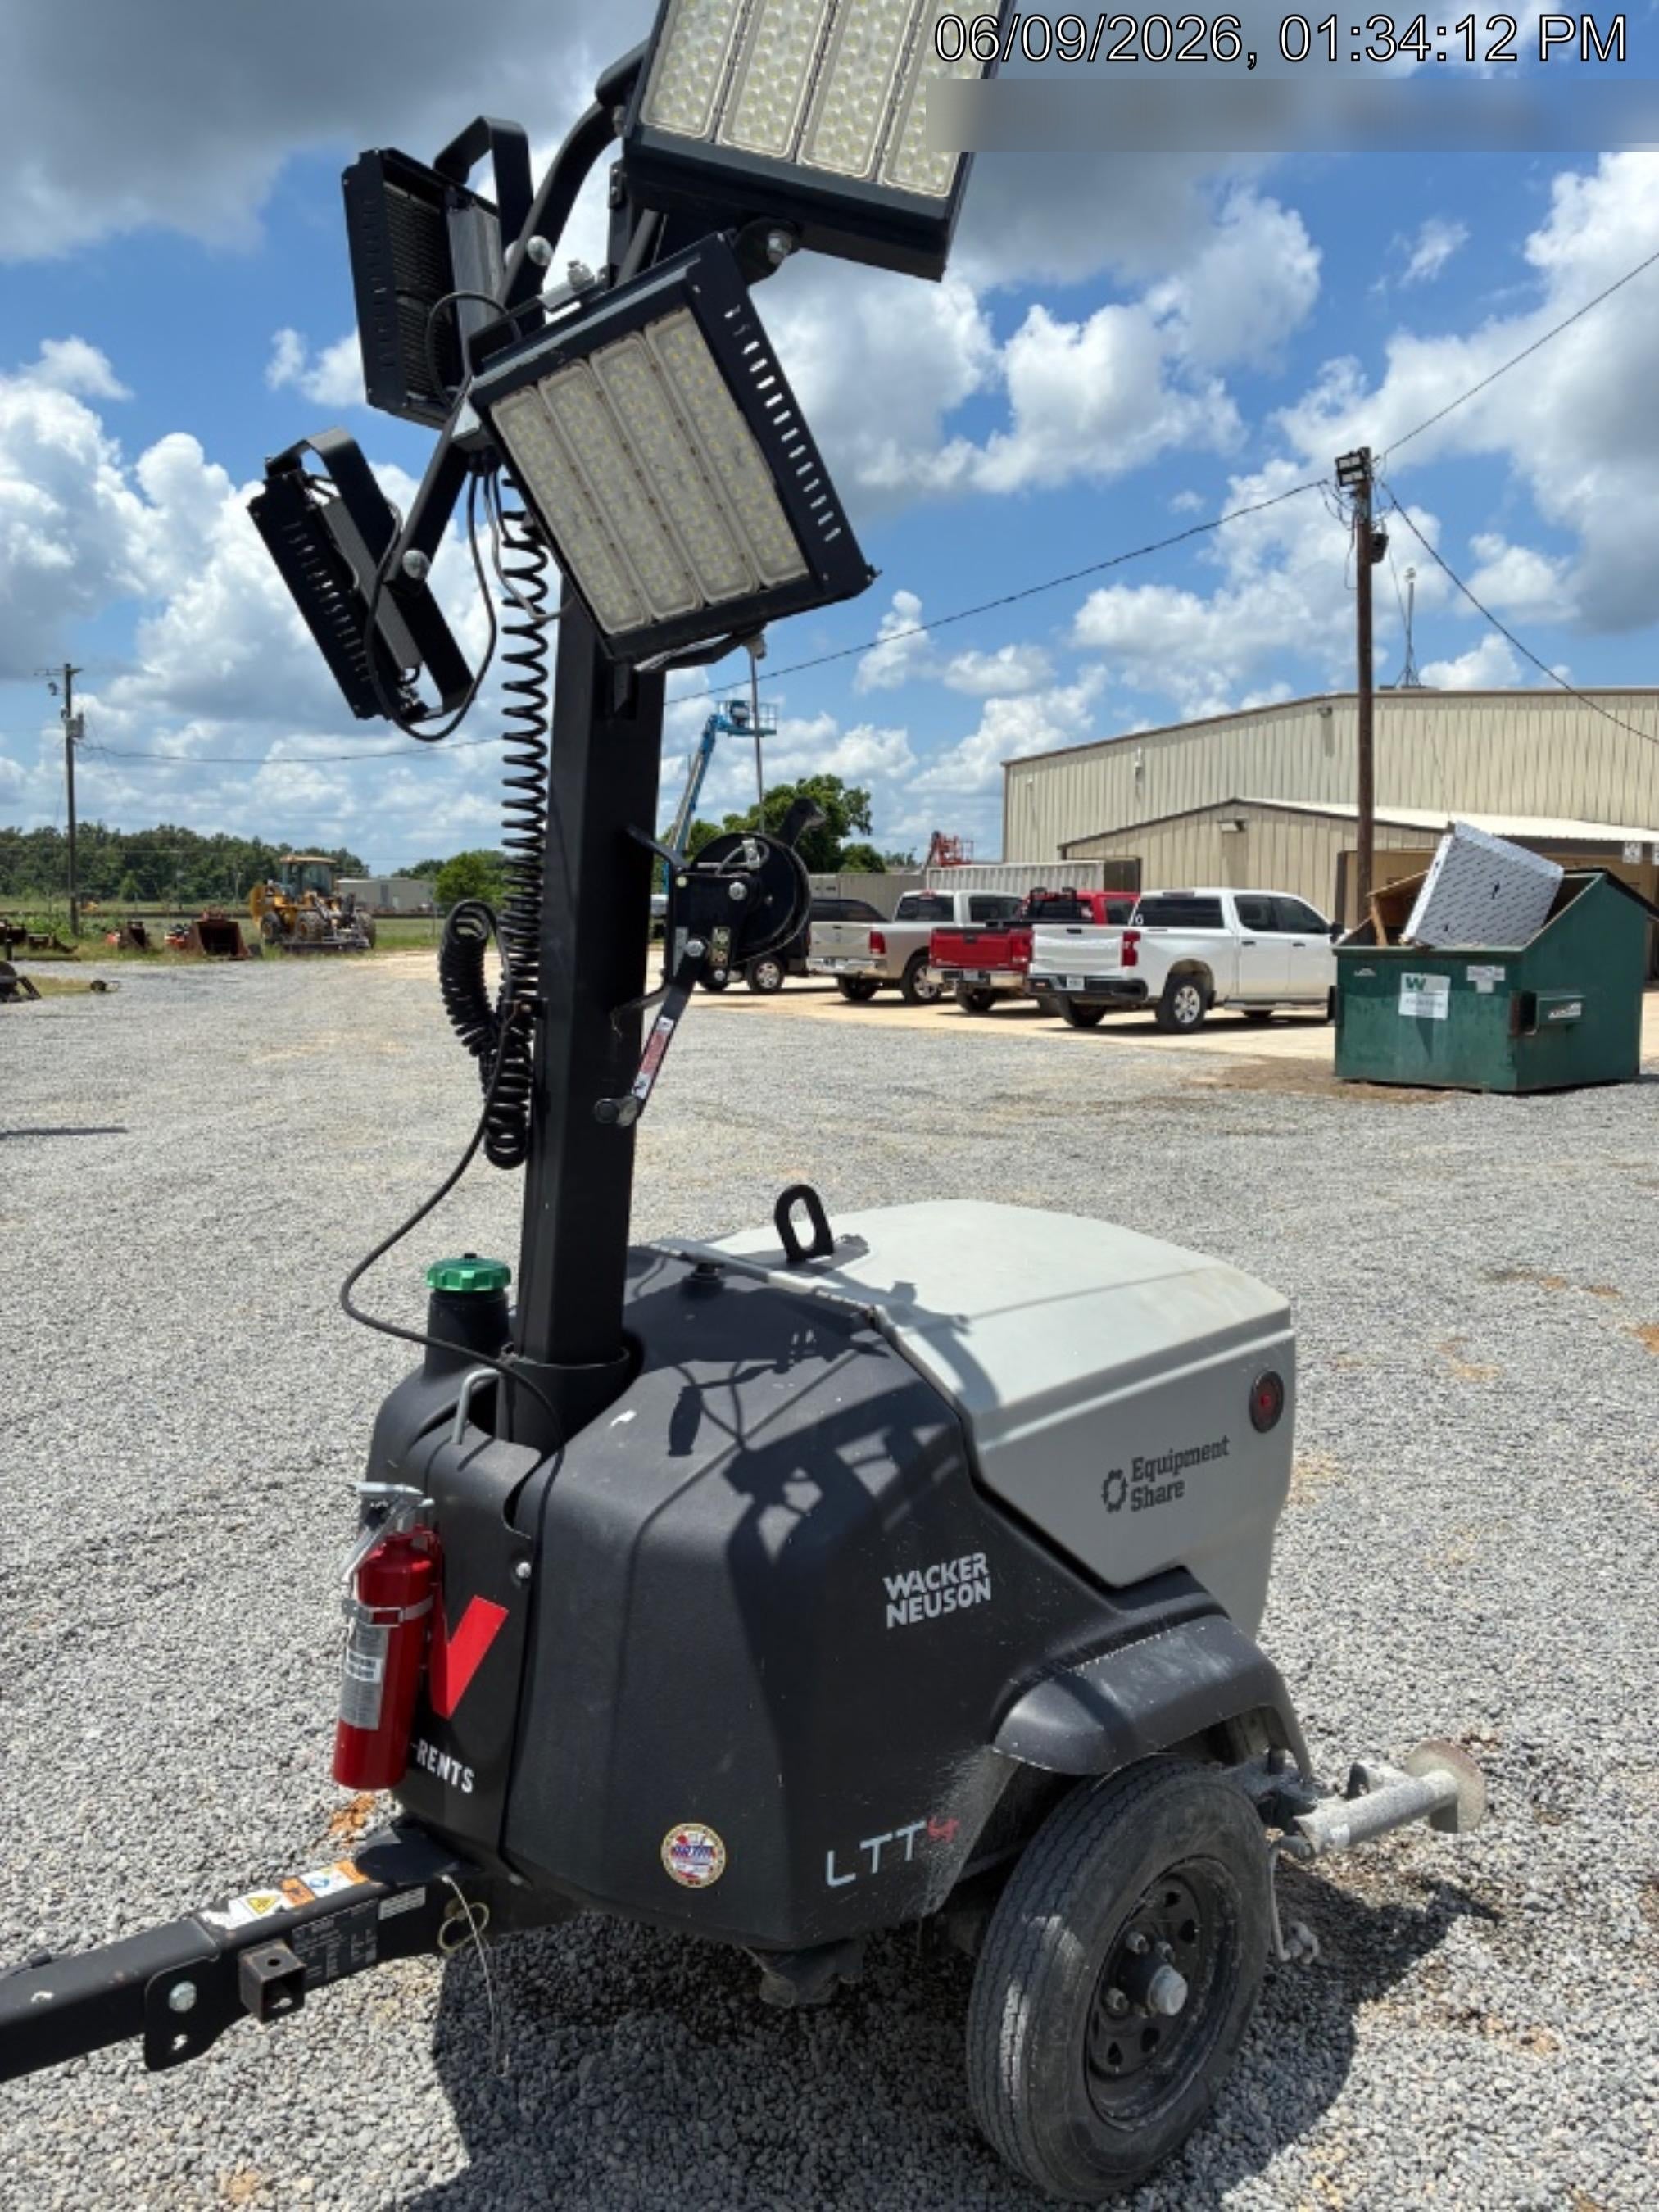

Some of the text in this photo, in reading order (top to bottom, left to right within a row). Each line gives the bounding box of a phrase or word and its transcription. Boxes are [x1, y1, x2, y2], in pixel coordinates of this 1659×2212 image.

[1131, 1435, 1230, 1483] Equipment
[1131, 1480, 1185, 1512] Share
[882, 1552, 990, 1601] WACKER
[886, 1577, 991, 1629] NEUSON
